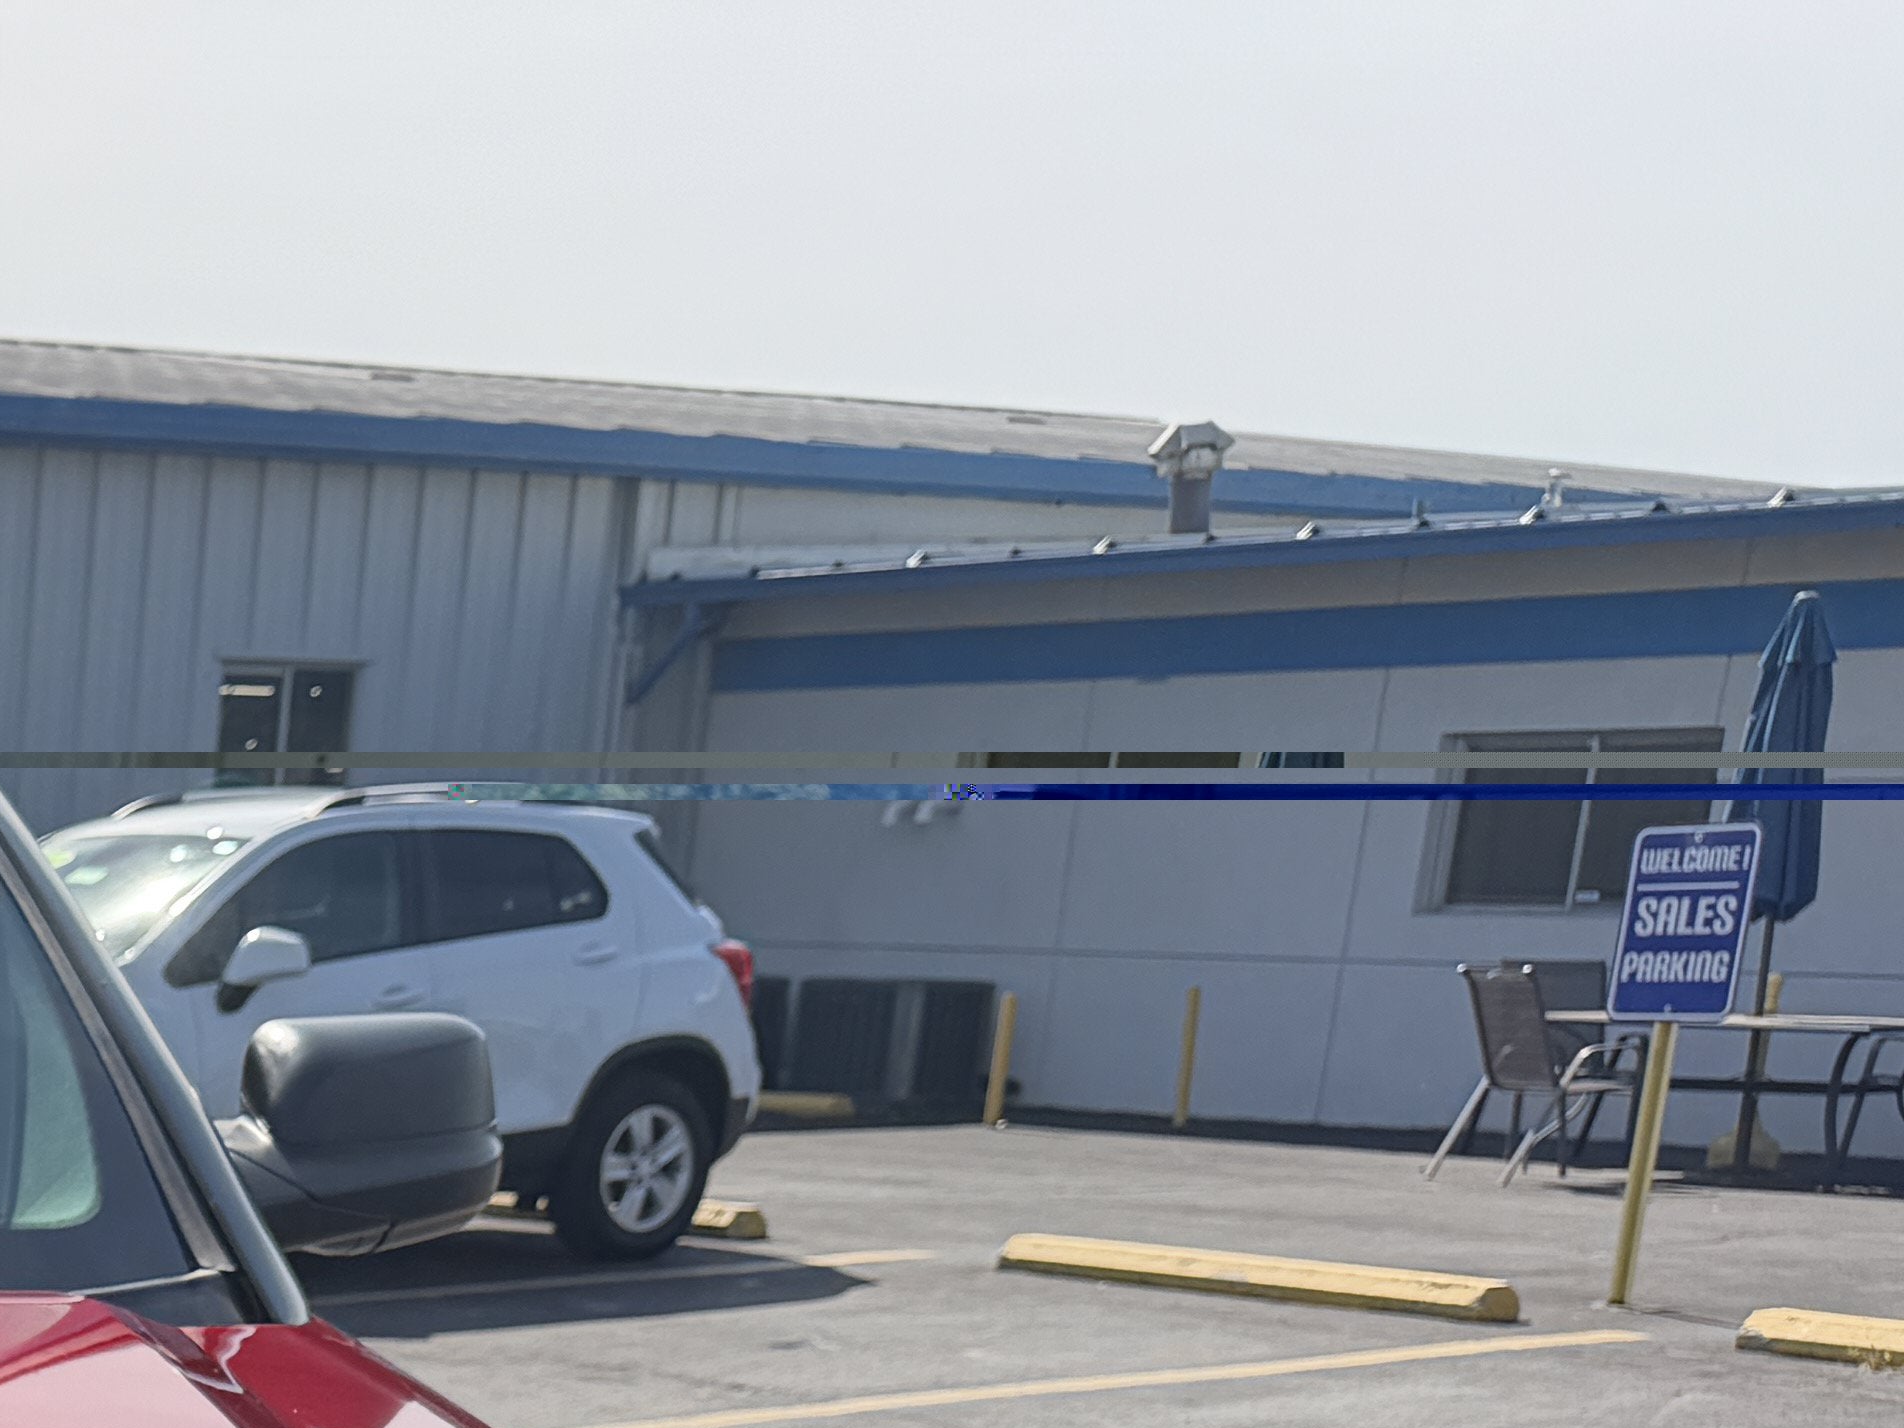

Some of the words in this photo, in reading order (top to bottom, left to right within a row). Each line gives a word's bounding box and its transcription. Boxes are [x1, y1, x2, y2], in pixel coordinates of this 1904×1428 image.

[1641, 845, 1751, 874] WELCOME!
[1634, 895, 1738, 937] SALES
[1620, 950, 1731, 983] PARKING
